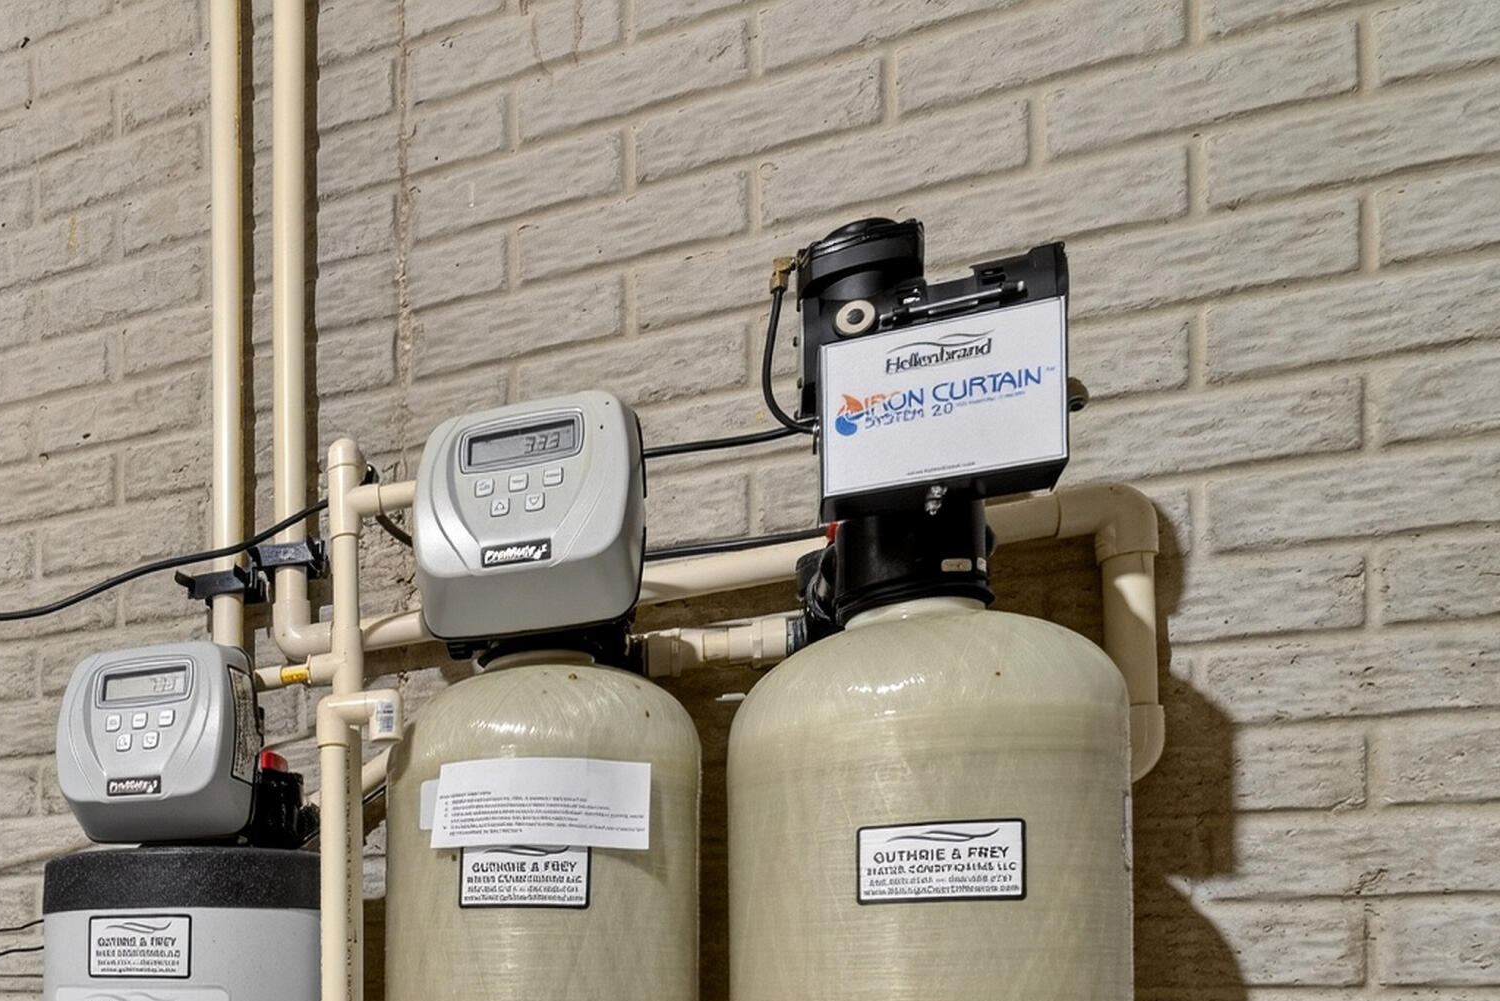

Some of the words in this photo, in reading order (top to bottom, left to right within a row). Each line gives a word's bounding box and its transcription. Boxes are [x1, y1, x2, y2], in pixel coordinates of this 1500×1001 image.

[885, 337, 993, 375] Hellenbrand
[864, 387, 925, 416] IRON
[932, 365, 1042, 402] CURTAIN
